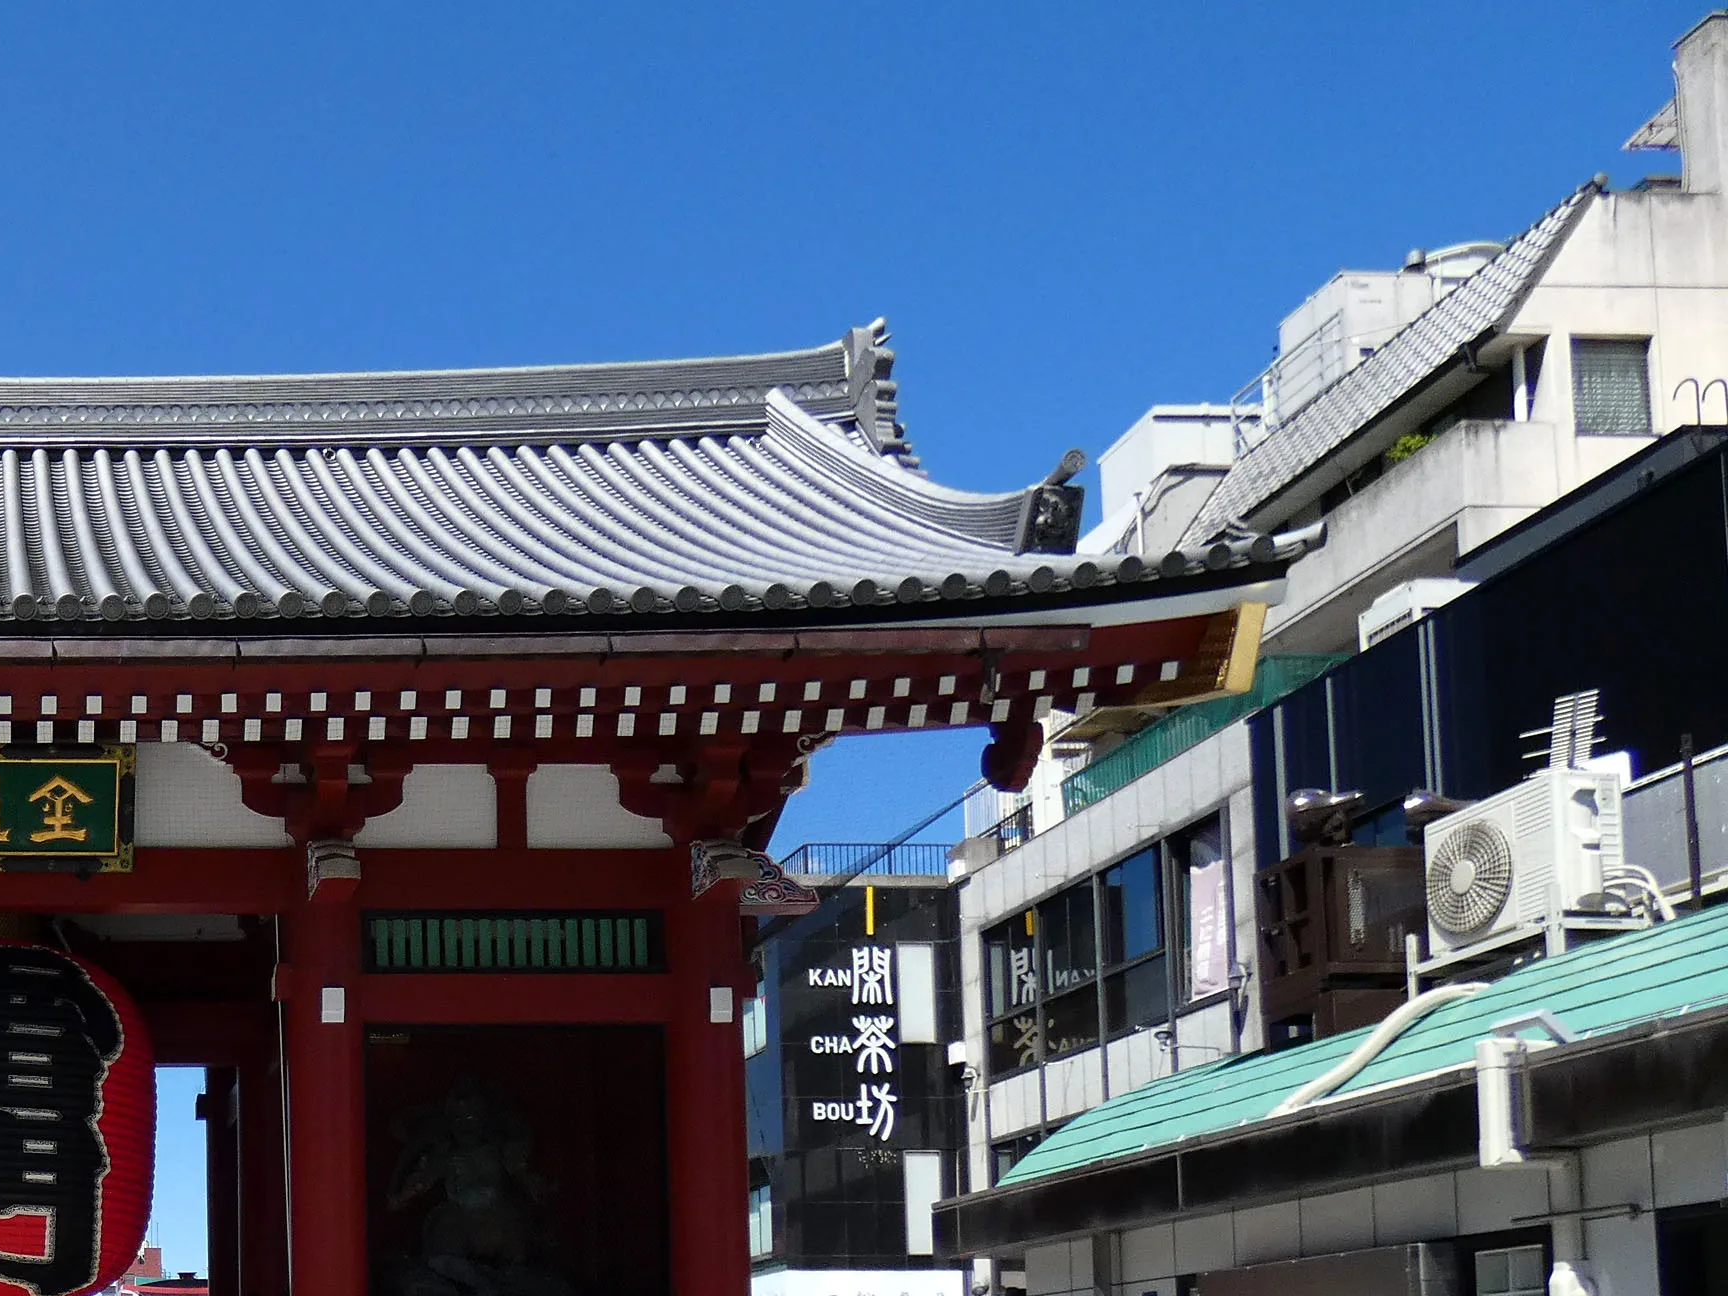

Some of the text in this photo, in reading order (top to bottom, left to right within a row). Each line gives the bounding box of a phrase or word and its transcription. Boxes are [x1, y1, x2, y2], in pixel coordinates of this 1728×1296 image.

[808, 968, 852, 987] KAN
[811, 1036, 854, 1054] CHA
[813, 1102, 854, 1121] BOU
